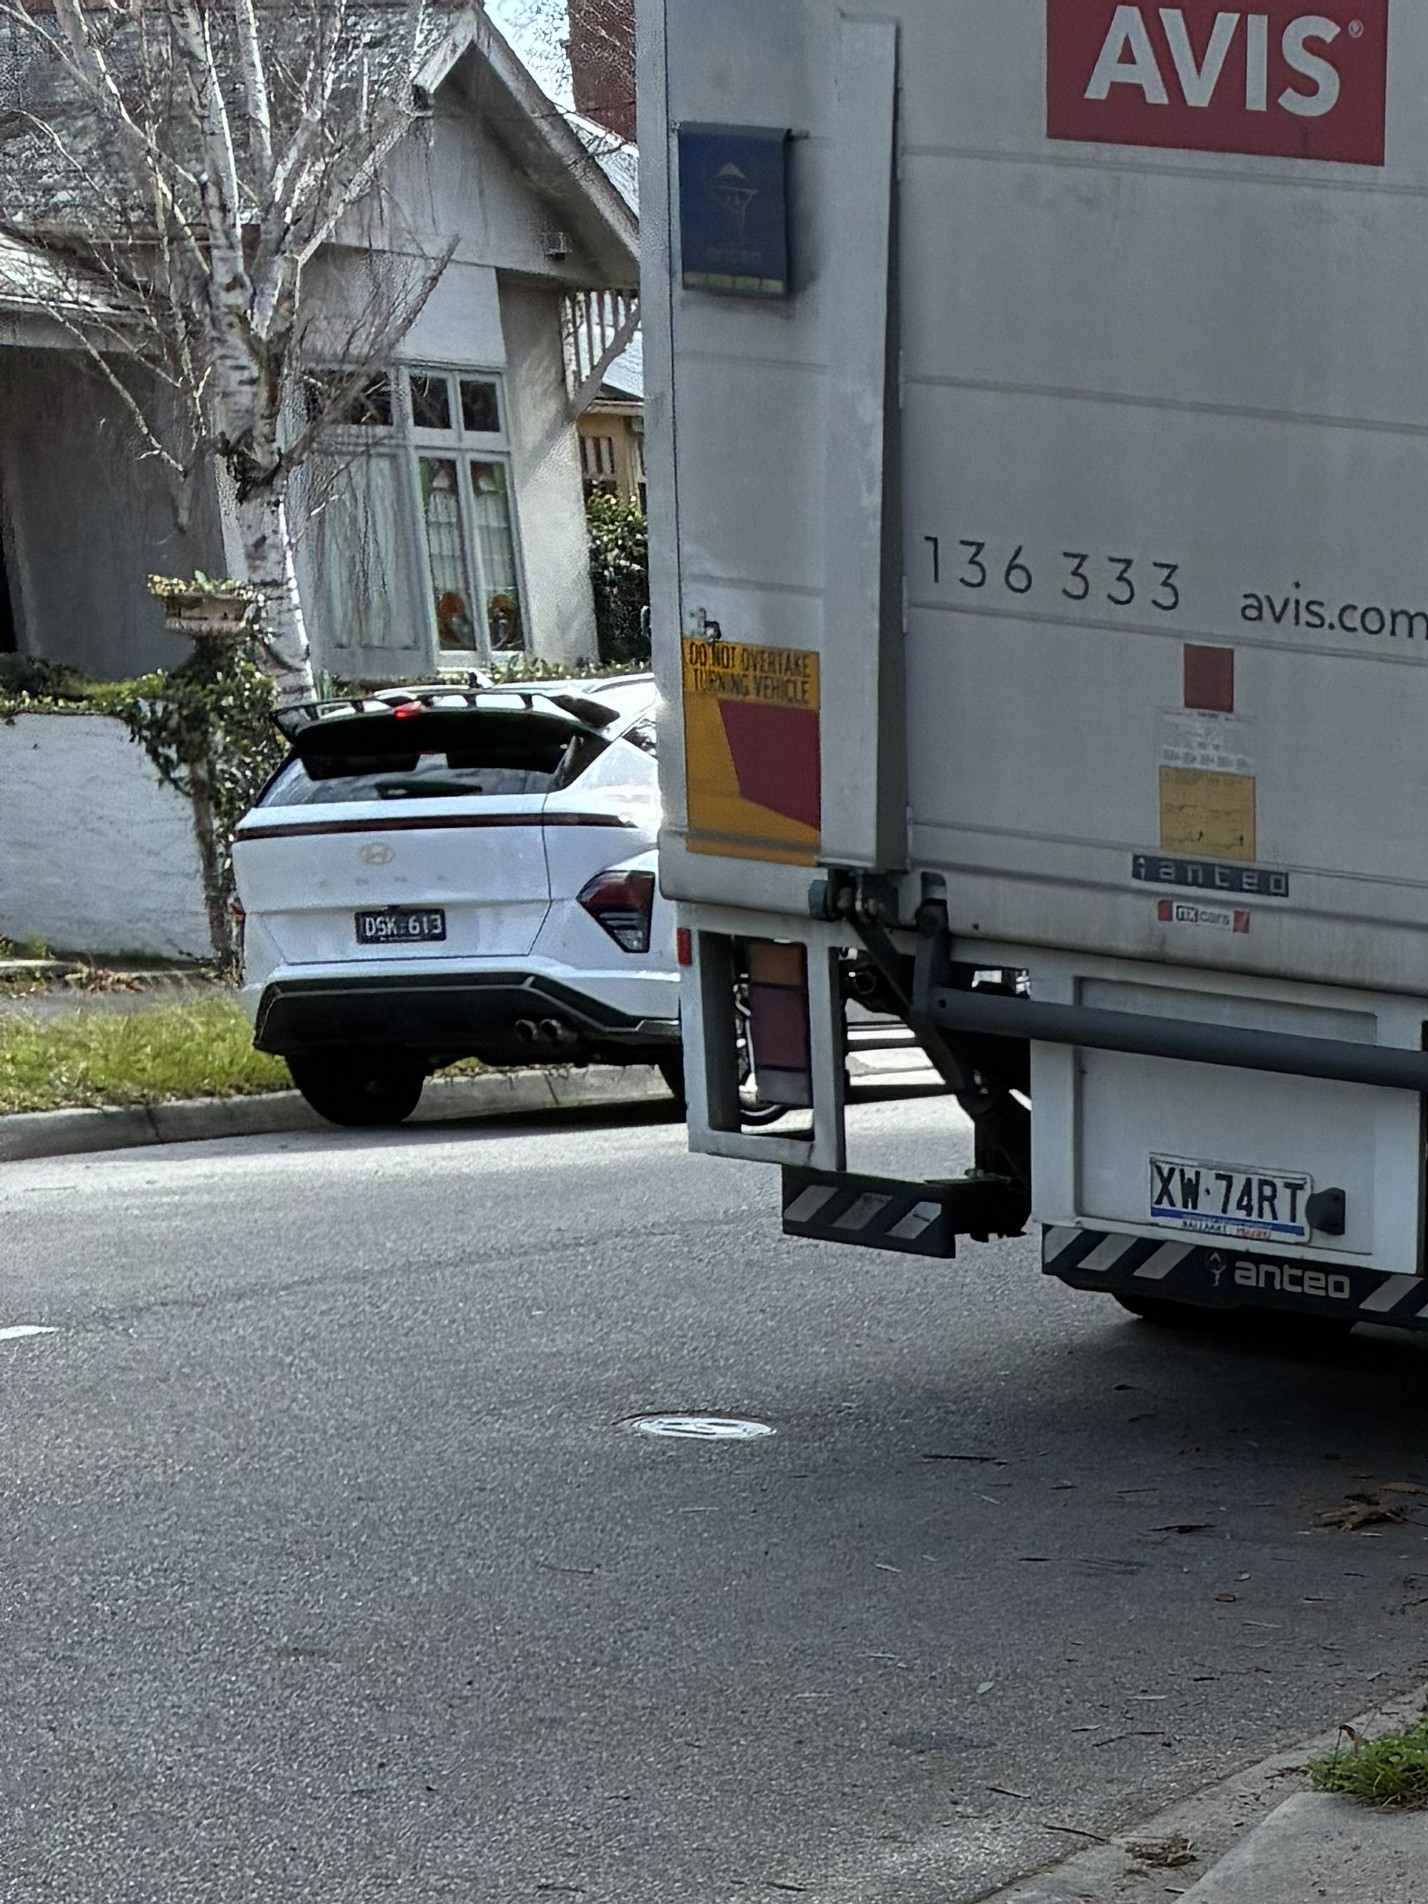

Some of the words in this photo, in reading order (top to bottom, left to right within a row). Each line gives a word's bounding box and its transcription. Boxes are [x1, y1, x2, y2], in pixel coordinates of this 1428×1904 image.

[1084, 5, 1342, 117] AVIS
[924, 536, 1033, 594] 136
[1061, 551, 1181, 612] 333
[689, 641, 707, 667] DO
[711, 642, 737, 669] NOT
[741, 647, 811, 678] OVERTAKE
[693, 667, 749, 697] TURNING
[754, 675, 810, 702] VEHICLE
[408, 913, 443, 935] 613
[1234, 1259, 1350, 1300] anteo
